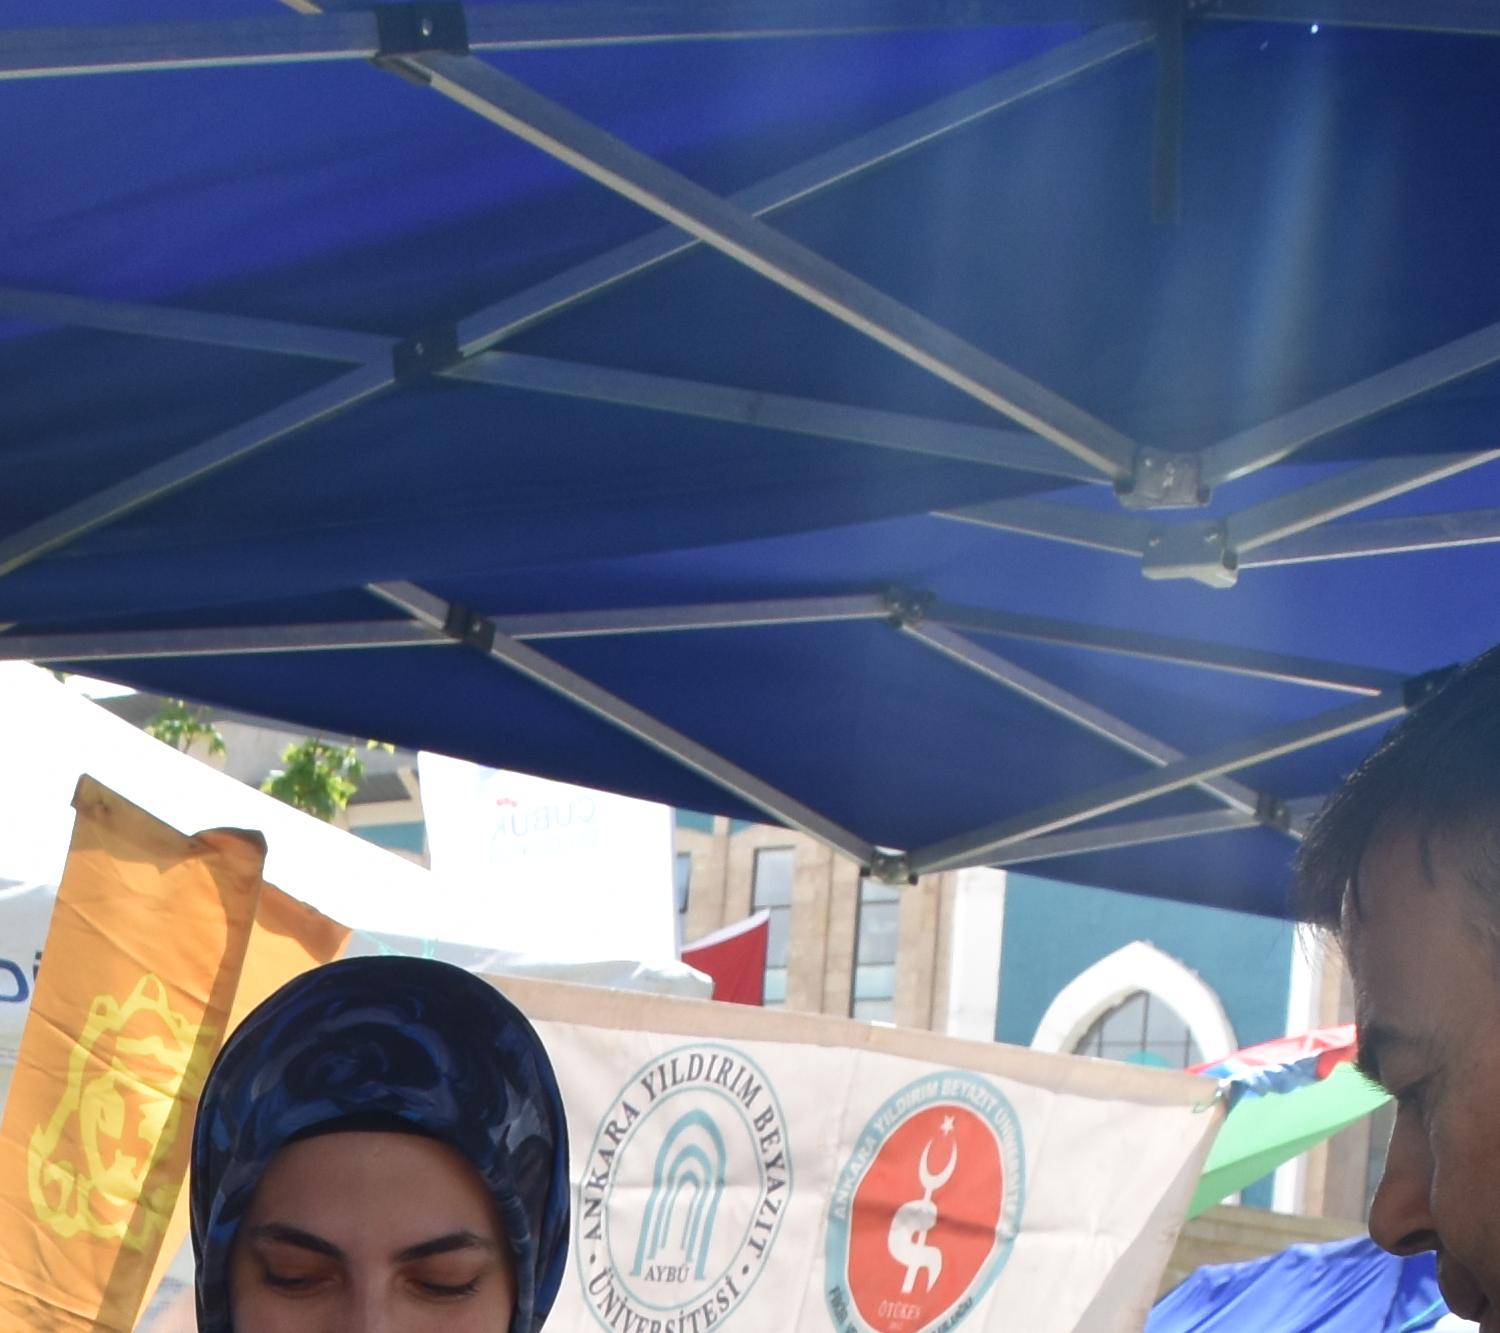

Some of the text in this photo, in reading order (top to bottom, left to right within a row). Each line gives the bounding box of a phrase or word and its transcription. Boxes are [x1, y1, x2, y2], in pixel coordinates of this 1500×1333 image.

[583, 1052, 787, 1259] ANKARA YILDIRIM BEYAZIT
[643, 1264, 690, 1284] AYBÜ
